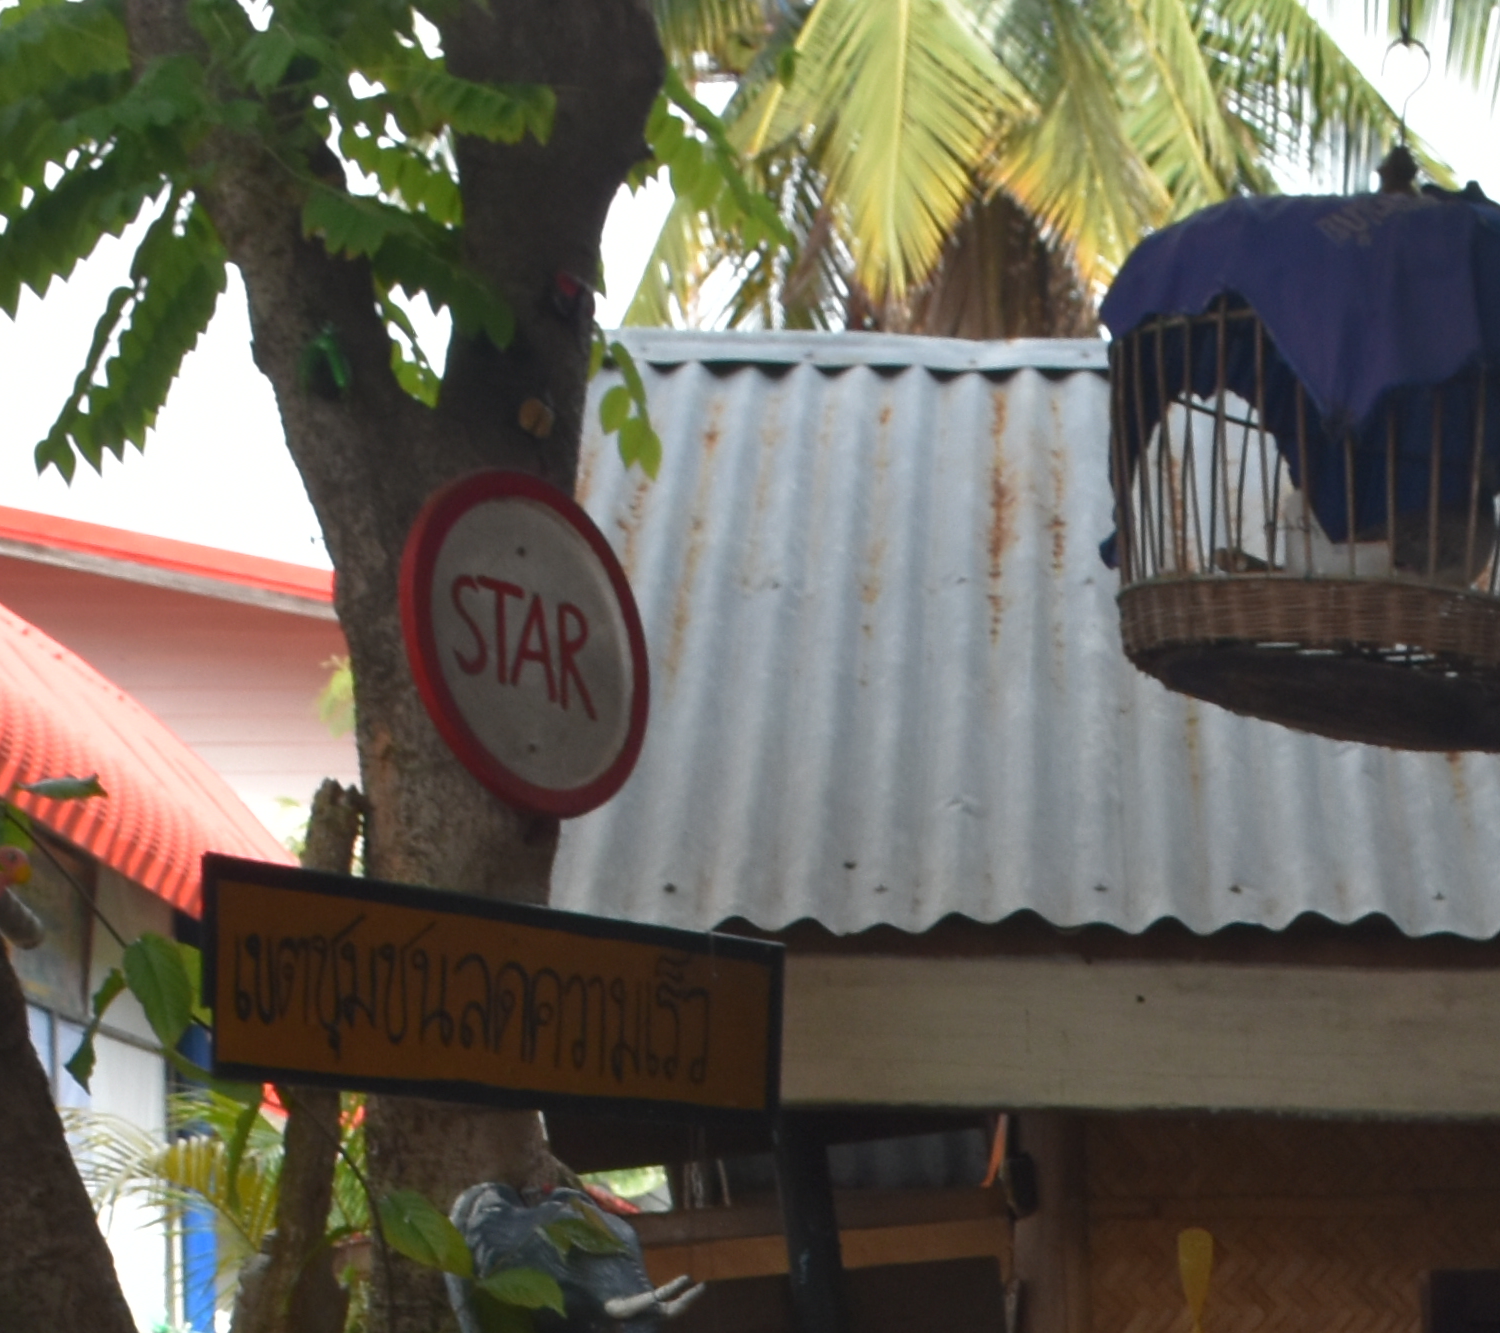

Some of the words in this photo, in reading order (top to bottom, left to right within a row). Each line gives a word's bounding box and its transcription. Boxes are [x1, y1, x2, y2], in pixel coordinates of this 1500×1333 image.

[451, 574, 597, 721] STAR
[235, 914, 711, 1084] เขตชุมชนลดความเร็ว
